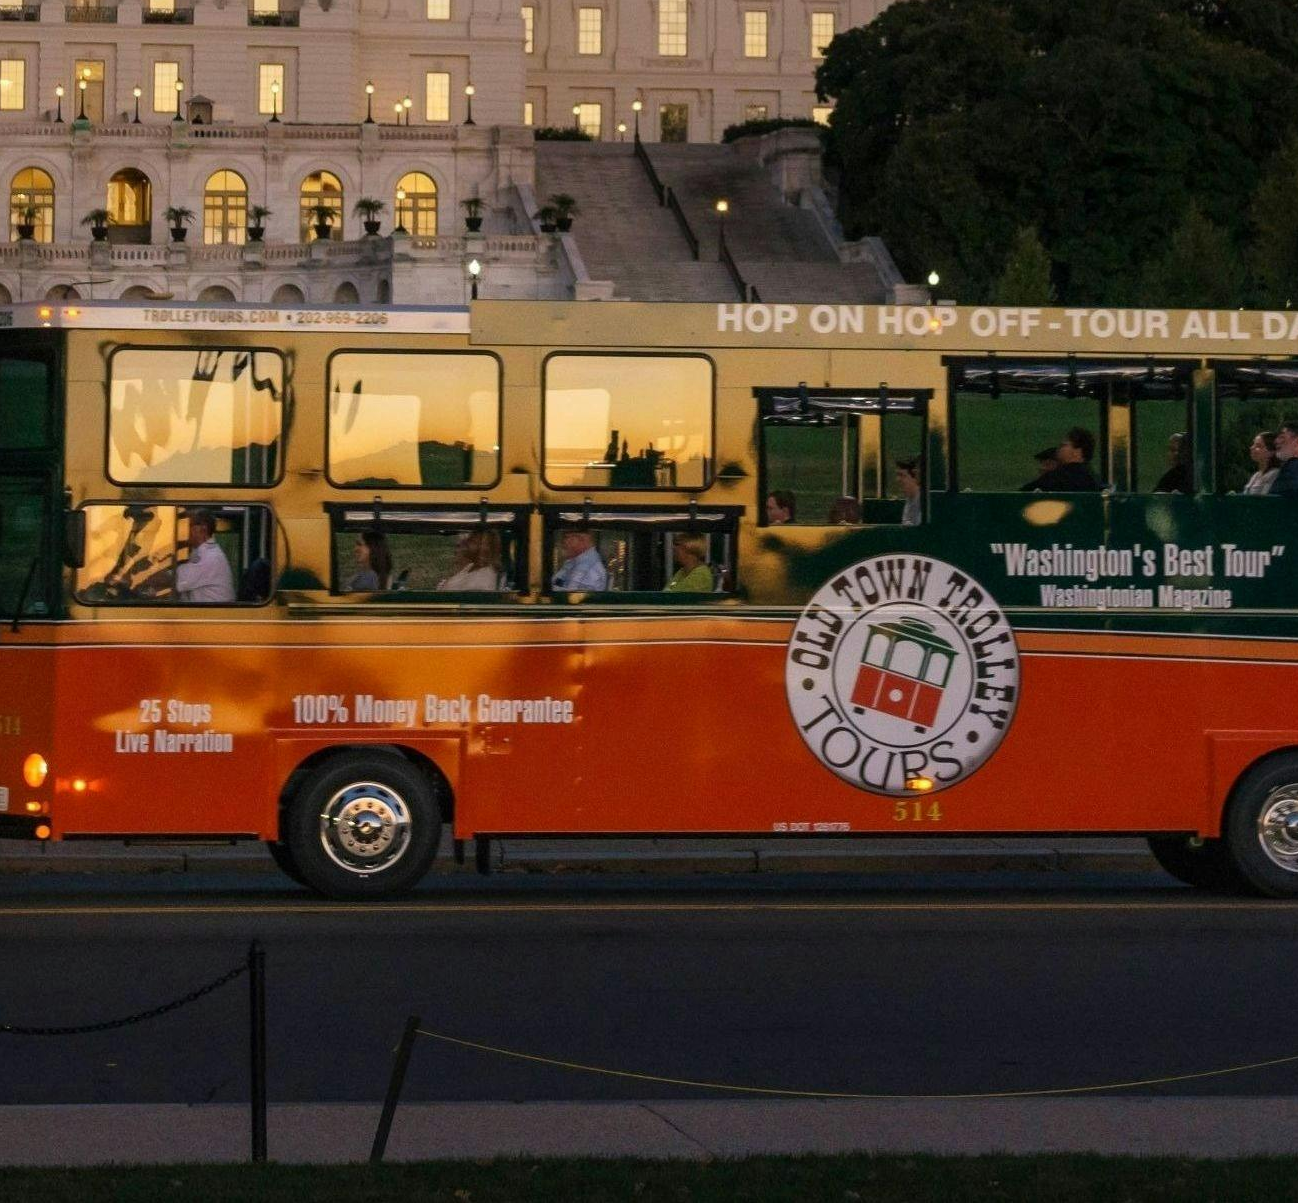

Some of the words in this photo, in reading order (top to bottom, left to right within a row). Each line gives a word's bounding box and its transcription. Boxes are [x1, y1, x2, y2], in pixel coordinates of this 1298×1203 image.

[143, 309, 280, 323] TROLLEYTOURS.COM
[717, 304, 797, 333] HOP
[809, 304, 864, 334] ON
[878, 305, 958, 336] HOP
[970, 307, 1042, 338] OFF
[1181, 310, 1251, 340] ALL
[1164, 543, 1215, 577] Best
[1040, 584, 1154, 610] Washingtonian
[1158, 585, 1233, 611] Magazine
[791, 603, 843, 671] OLD
[831, 558, 933, 612] TOWN
[937, 571, 1016, 730] TROLLEY
[139, 699, 162, 724] 25
[166, 699, 213, 726] Stops
[293, 694, 347, 725] 100%
[355, 695, 417, 727] Money
[424, 694, 471, 723] Back
[477, 694, 575, 725] Guarantee
[115, 729, 150, 753] Live
[153, 730, 234, 754] Narration
[801, 694, 963, 791] TOURS
[893, 801, 943, 821] 514
